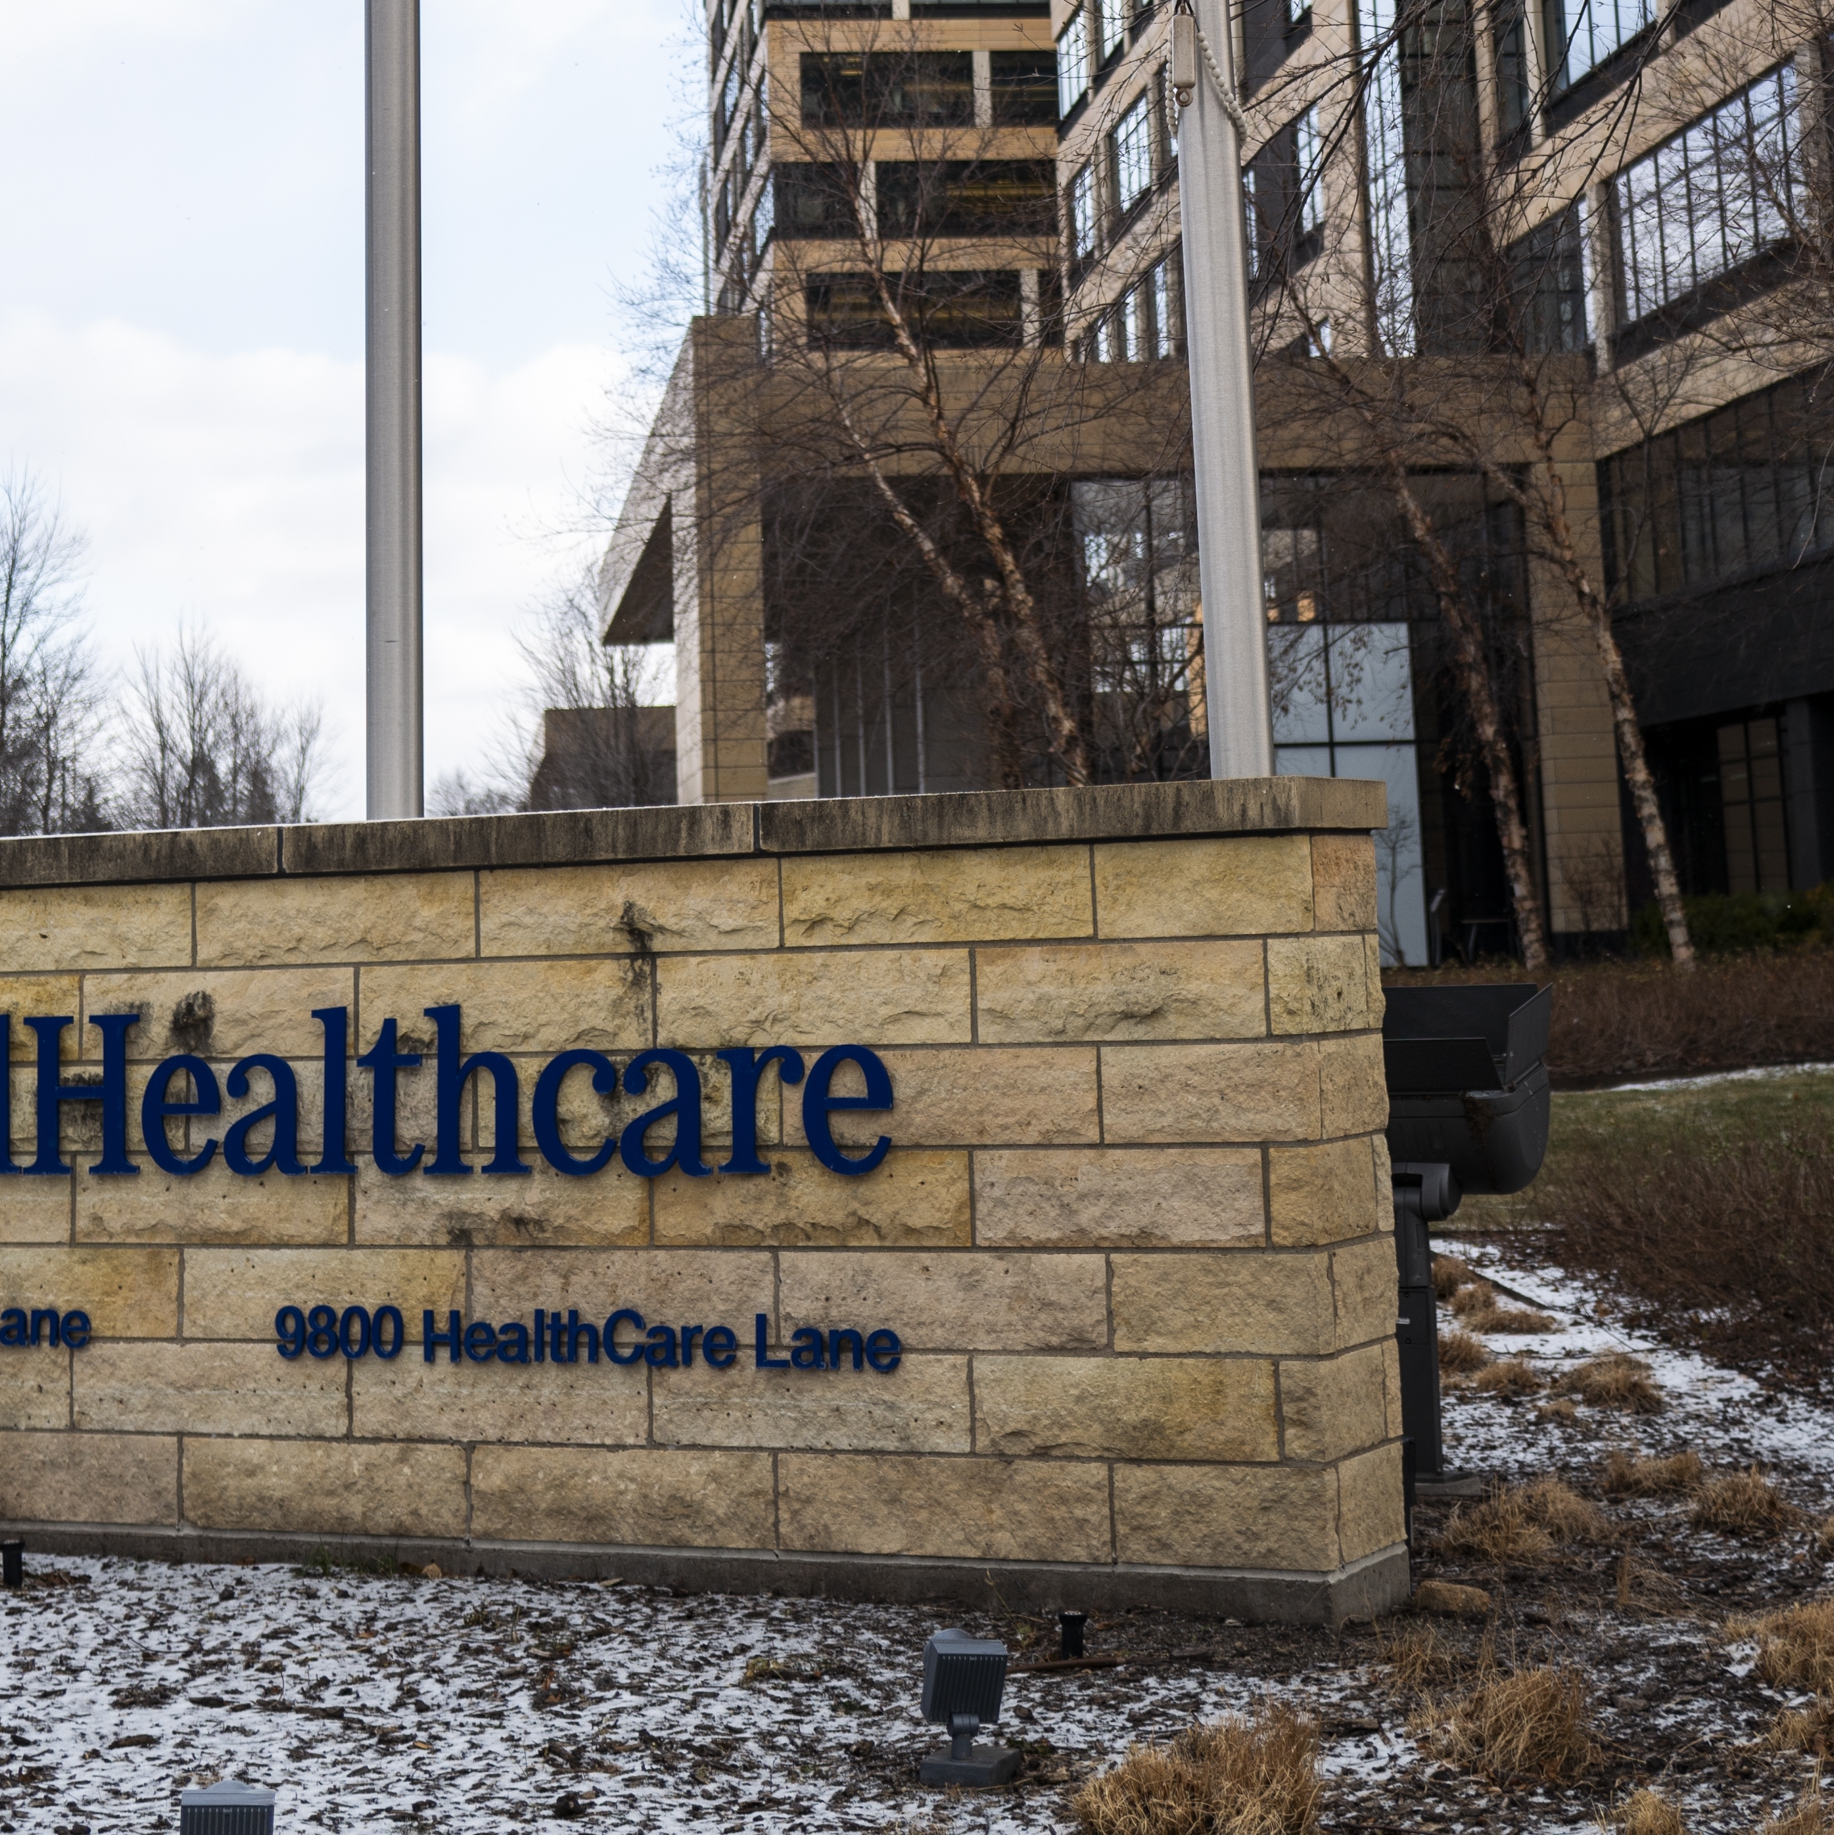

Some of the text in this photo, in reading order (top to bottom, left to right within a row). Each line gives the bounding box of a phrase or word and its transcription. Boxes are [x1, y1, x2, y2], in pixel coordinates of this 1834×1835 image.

[274, 1304, 902, 1373] 9800 HealthCare Lane
